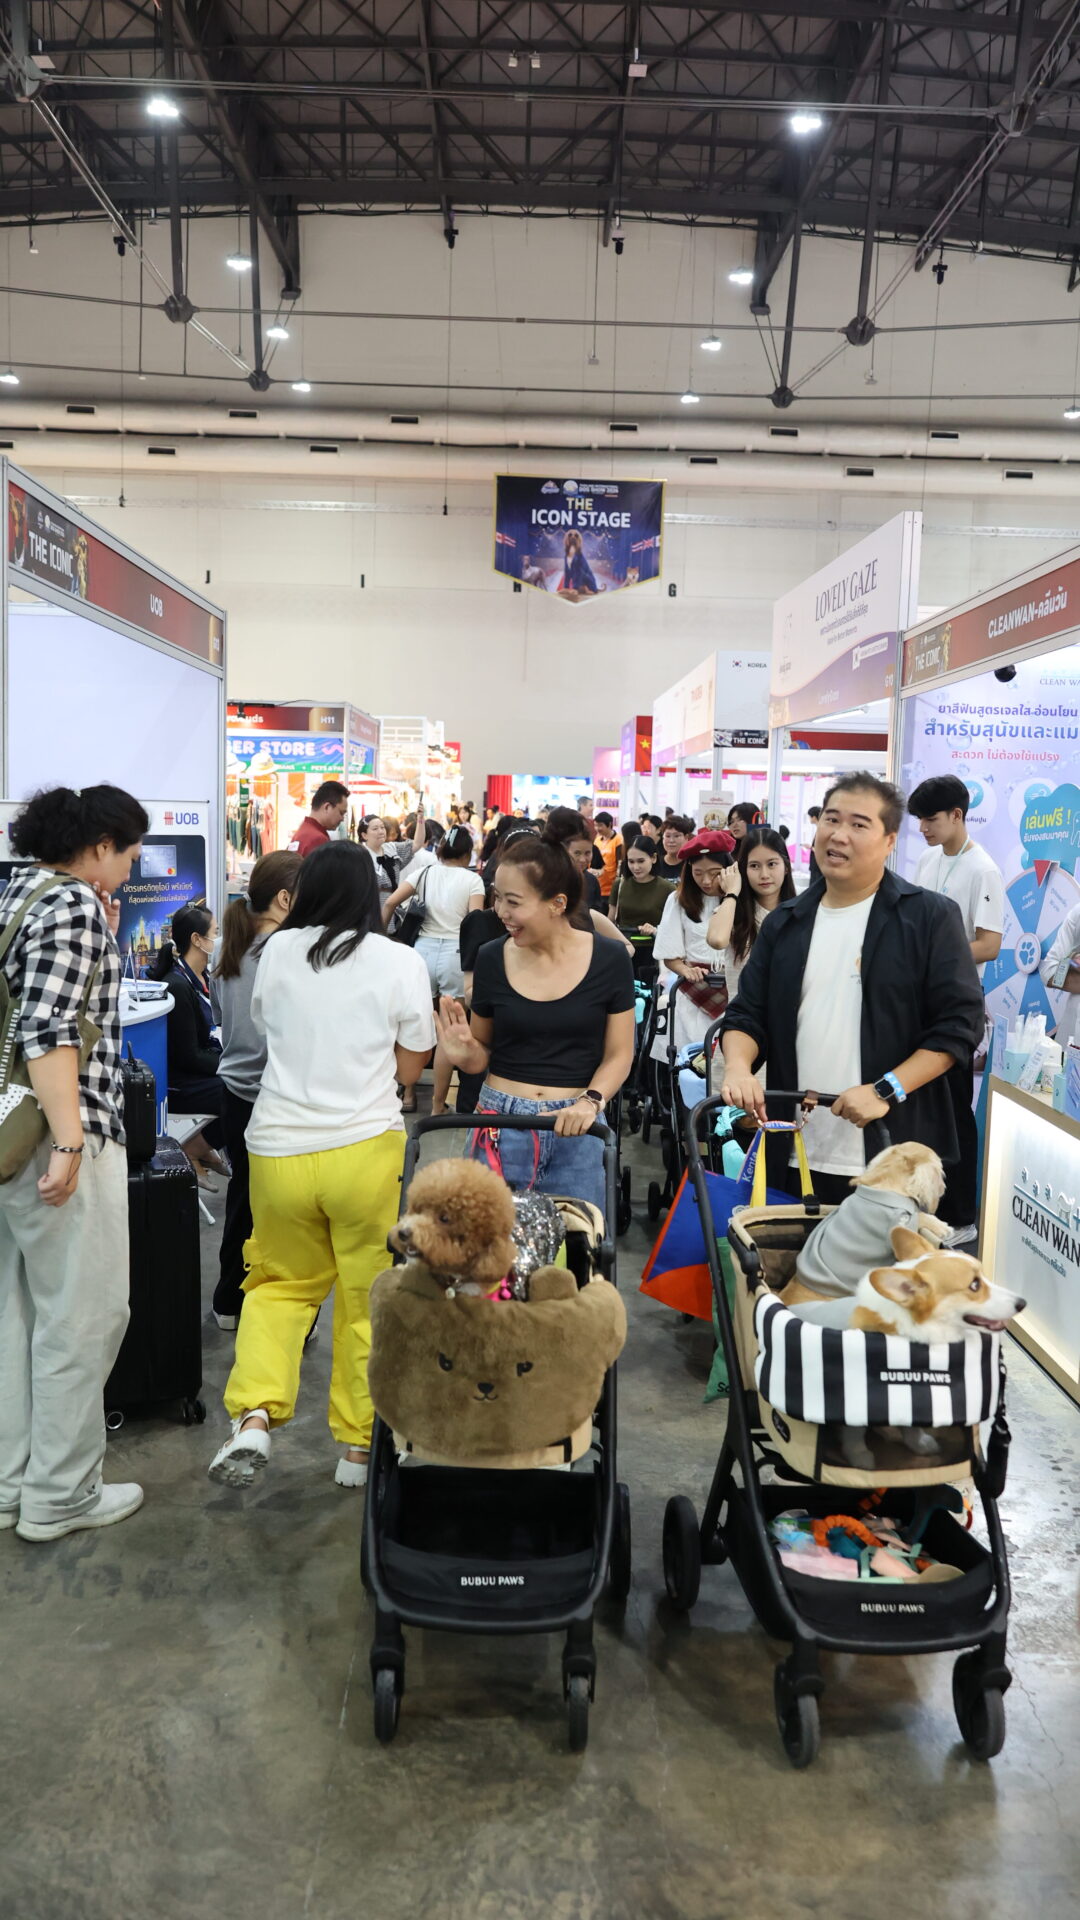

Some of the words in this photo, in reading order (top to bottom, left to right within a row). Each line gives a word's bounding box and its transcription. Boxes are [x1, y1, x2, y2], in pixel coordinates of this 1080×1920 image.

[566, 497, 594, 510] THE
[532, 509, 573, 525] ICON
[577, 511, 631, 528] STAGE
[28, 530, 48, 565] THE
[49, 542, 74, 578] ICONIC
[668, 583, 677, 598] G
[815, 577, 848, 622] LOVELY
[850, 558, 878, 602] GAZE
[150, 593, 163, 617] UOB
[915, 653, 926, 672] THE
[320, 716, 335, 724] H11
[260, 741, 316, 757] STORE
[951, 749, 984, 760] สะดวก
[175, 813, 199, 825] UOB
[1025, 807, 1065, 830] เล่นฟรี
[3, 1040, 13, 1053] ART
[1012, 1195, 1050, 1242] CLEAN
[1051, 1223, 1080, 1267] WAN
[880, 1371, 921, 1382] BUBUU
[922, 1372, 952, 1383] PAWS
[460, 1576, 496, 1586] BUBUU
[498, 1575, 525, 1585] PAWS
[860, 1603, 897, 1613] BUBUU
[898, 1603, 926, 1613] PAWS
